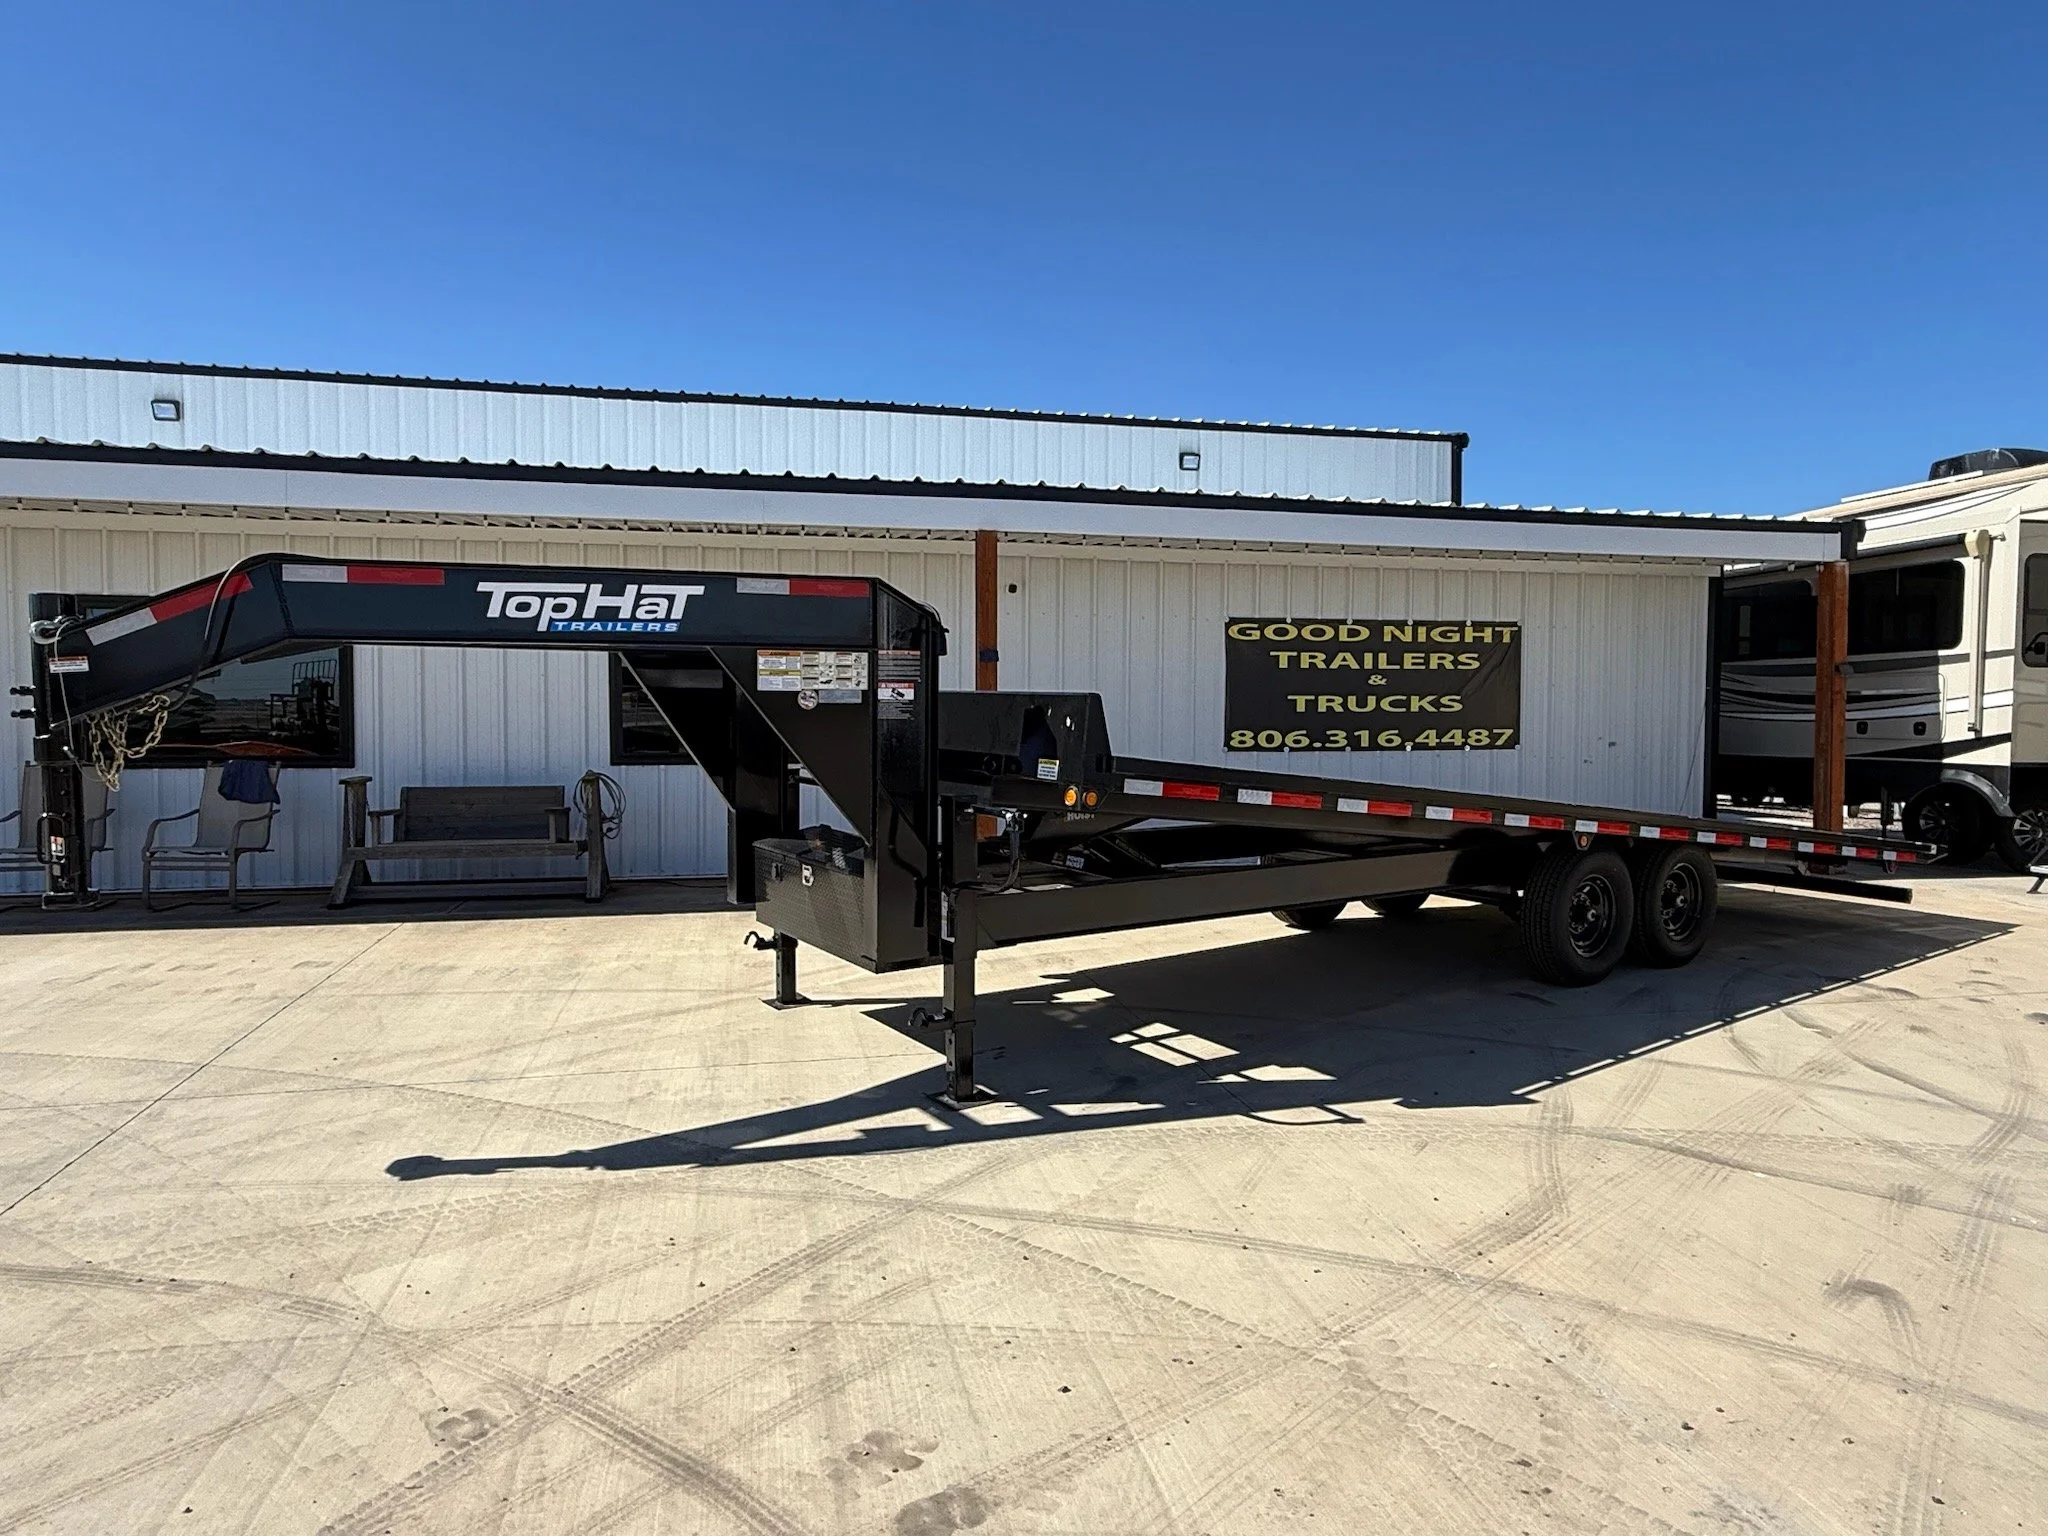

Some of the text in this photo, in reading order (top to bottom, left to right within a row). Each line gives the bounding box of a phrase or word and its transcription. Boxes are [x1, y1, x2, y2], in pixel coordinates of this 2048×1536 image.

[553, 621, 679, 632] TRAILERS
[1227, 623, 1519, 644] GOOD NIGHT
[1269, 651, 1481, 670] TRAILERS
[1367, 674, 1388, 686] &
[1287, 695, 1464, 713] TRUCKS
[1229, 728, 1514, 748] 806.316.4487
